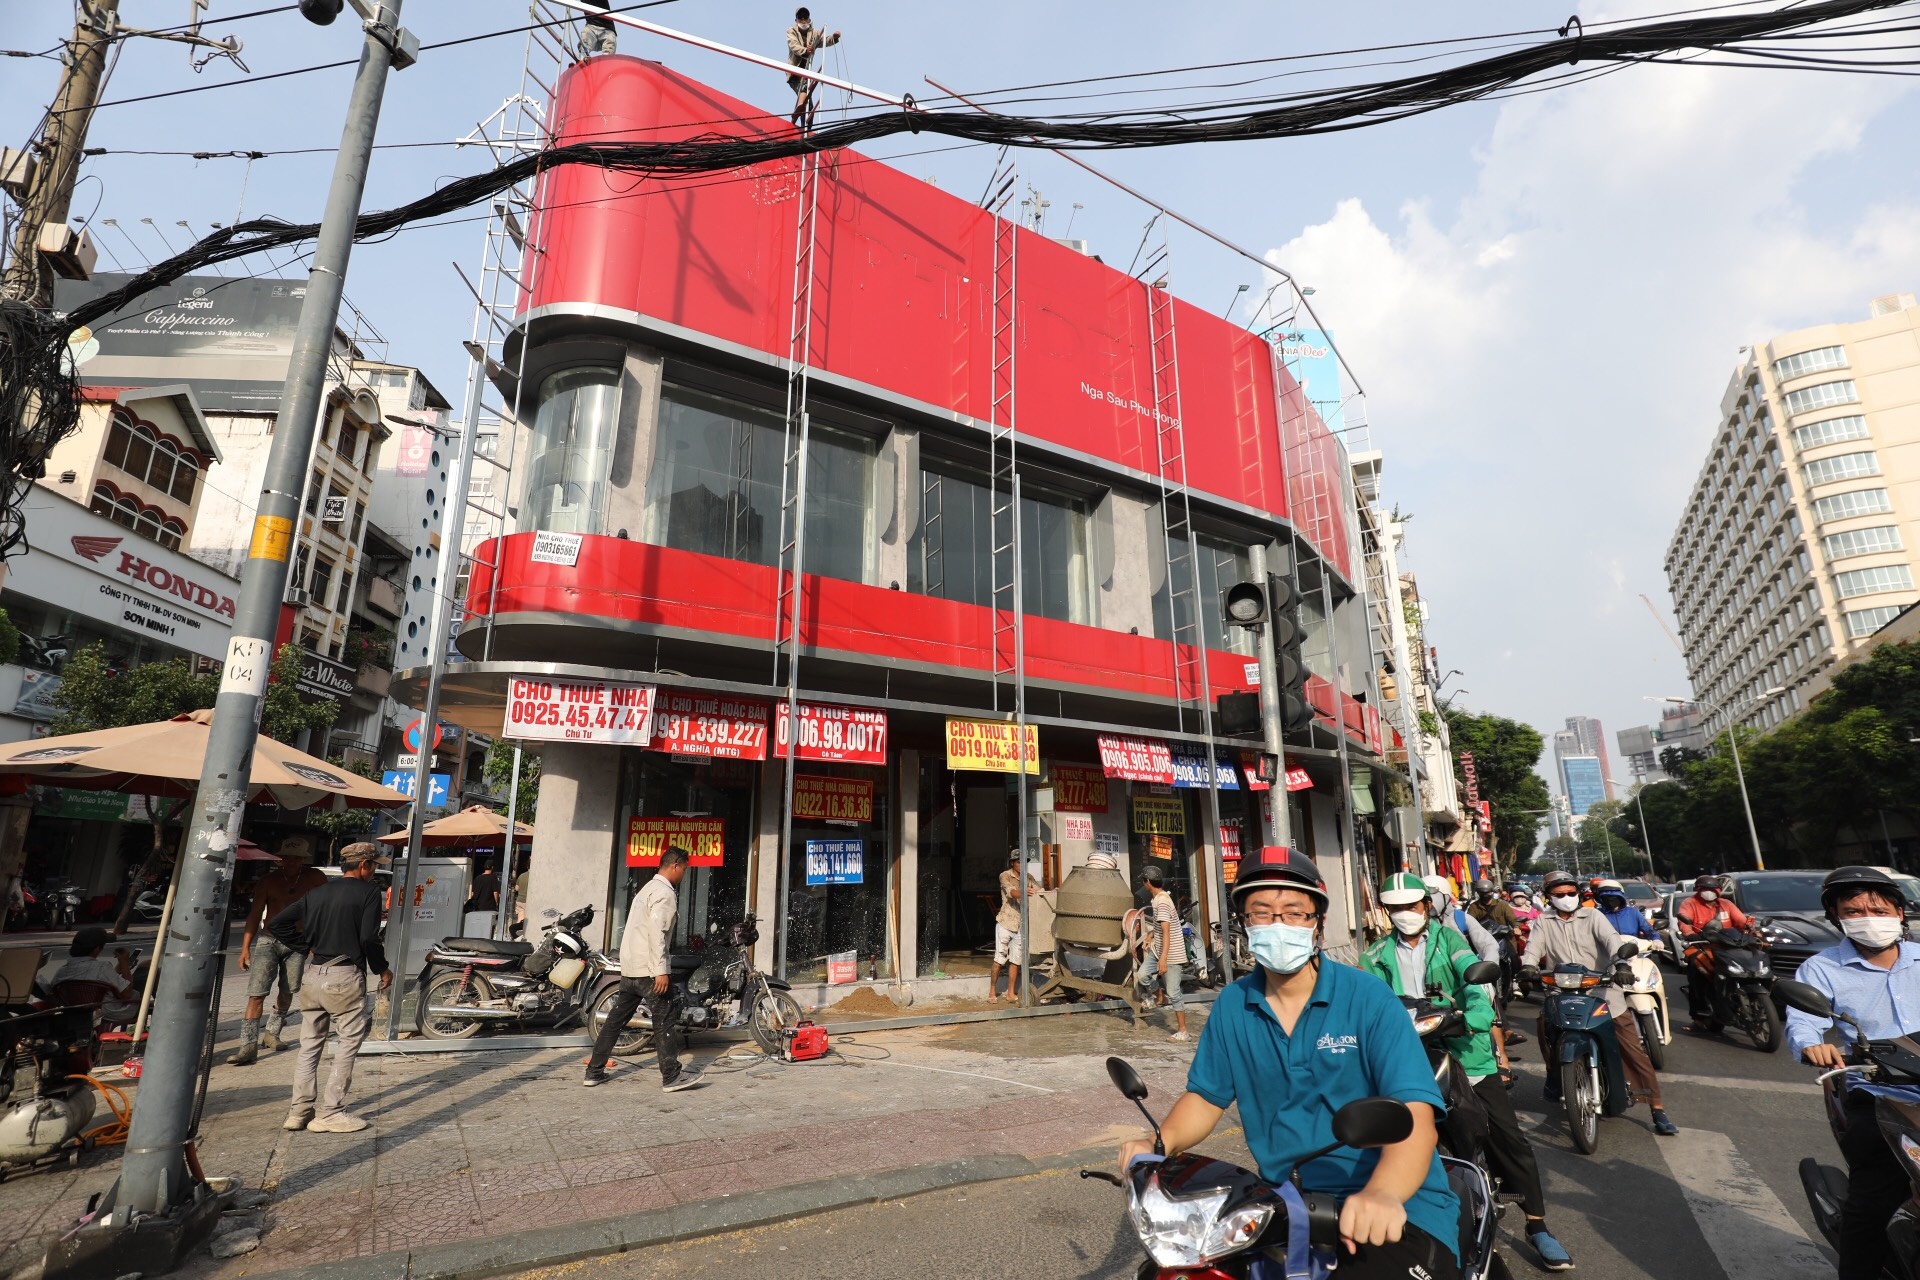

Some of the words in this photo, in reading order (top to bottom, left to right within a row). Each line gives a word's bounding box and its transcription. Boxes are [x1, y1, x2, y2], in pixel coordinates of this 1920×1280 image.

[178, 299, 214, 310] Legend
[144, 309, 238, 330] Cappuccino
[217, 329, 242, 337] Thành
[244, 330, 265, 338] Công
[1080, 381, 1104, 400] Nga
[1106, 391, 1128, 409] Sau
[1130, 400, 1150, 417] Phu
[265, 530, 276, 544] 4
[116, 551, 236, 619] HONDA
[100, 584, 121, 599] CÔNG
[122, 592, 132, 603] TY
[133, 597, 151, 611] TNHH
[186, 618, 201, 630] MINH
[123, 610, 145, 627] SƠN
[146, 618, 169, 635] MINH
[170, 627, 176, 637] 1
[316, 662, 354, 692] White
[513, 680, 552, 701] CHO
[558, 682, 606, 705] THUÊ
[610, 685, 649, 708] NHÀ
[511, 701, 649, 731] 0925.45.47.47
[671, 697, 692, 712] CHO
[694, 698, 719, 715] THUÊ
[720, 702, 746, 720] HOẶC
[747, 703, 767, 720] BÁN
[814, 706, 851, 721] THUÊ
[854, 710, 884, 724] NHÀ
[565, 729, 580, 738] Chú
[582, 729, 593, 739] Tư
[650, 711, 765, 747] 0931.339.227
[950, 720, 975, 738] CHO
[977, 722, 1008, 741] THUÊ
[671, 742, 680, 751] A.
[713, 746, 740, 757] (MTG)
[1100, 734, 1120, 749] CHO
[1121, 737, 1148, 753] THUÊ
[1149, 739, 1169, 755] NHÀ
[1102, 748, 1172, 774] 0906.905.006
[1178, 755, 1197, 766] CHO
[796, 780, 809, 790] CHO
[810, 780, 824, 791] THUÊ
[825, 781, 837, 792] NHÀ
[838, 782, 856, 794] CHÍNH
[795, 792, 870, 819] 0922.16.36.36
[631, 821, 646, 831] CHO
[647, 820, 664, 831] THUÊ
[665, 820, 680, 832] NHÀ
[681, 820, 707, 832] NGUYÊN
[708, 820, 722, 832] CĂN
[808, 844, 824, 853] CHO
[825, 842, 844, 853] THUÊ
[845, 841, 861, 852] NHÀ
[808, 853, 861, 876] 0936.141.660
[1414, 1264, 1433, 1280] NIKE
